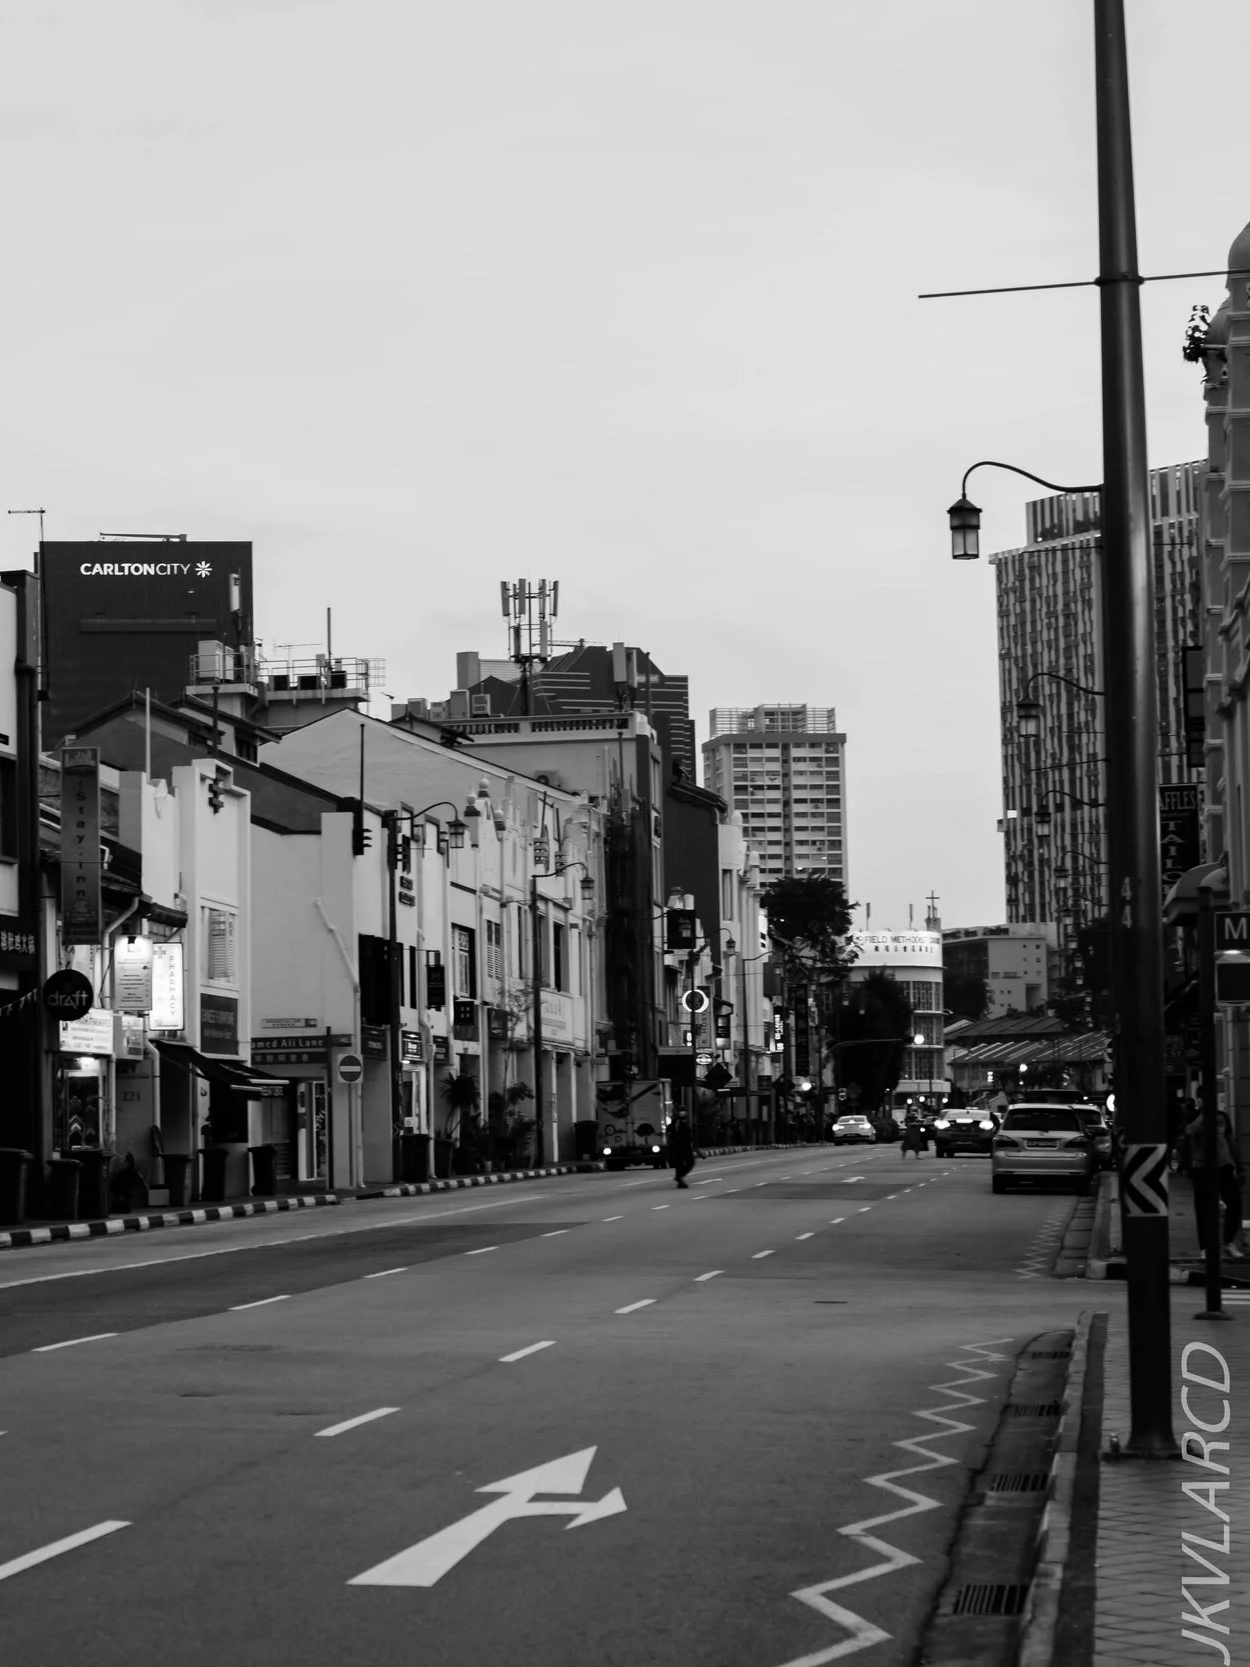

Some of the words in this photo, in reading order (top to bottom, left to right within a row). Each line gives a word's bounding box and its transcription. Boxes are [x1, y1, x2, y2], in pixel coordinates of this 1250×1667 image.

[1160, 791, 1196, 810] AFFLES
[1121, 876, 1133, 928] 44
[251, 1039, 277, 1048] amed
[280, 1038, 296, 1048] Ali
[298, 1038, 324, 1047] Lane
